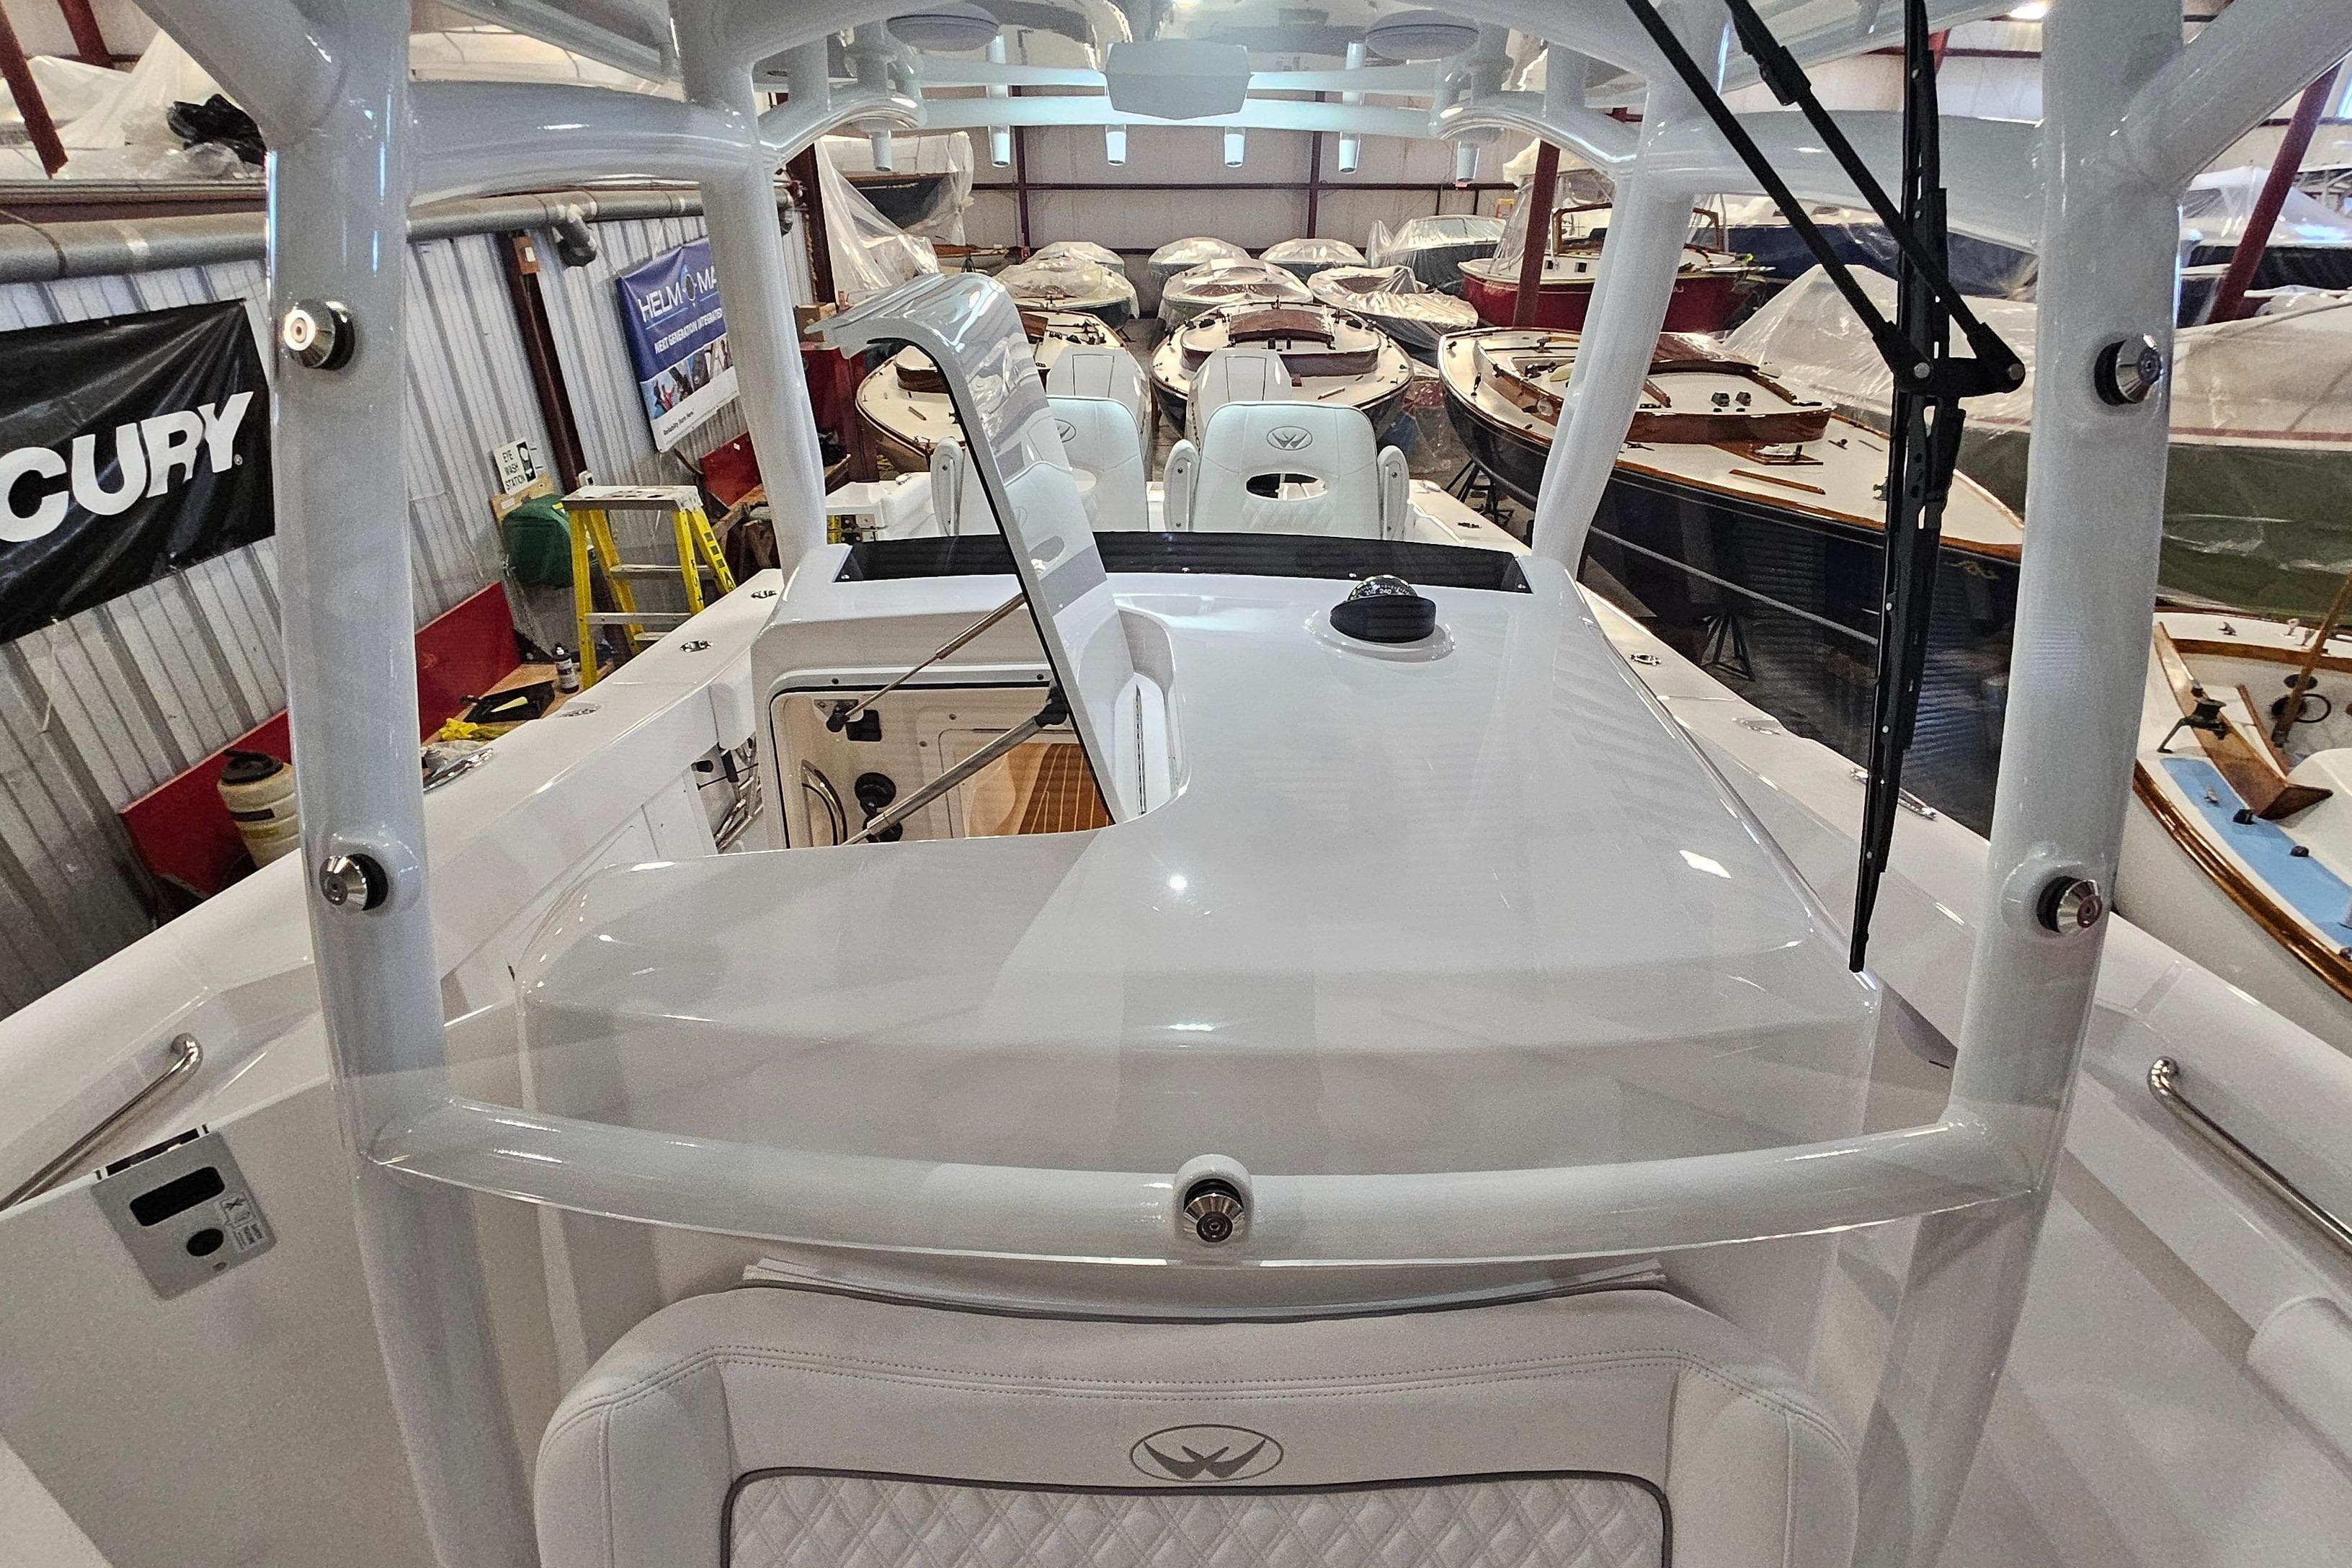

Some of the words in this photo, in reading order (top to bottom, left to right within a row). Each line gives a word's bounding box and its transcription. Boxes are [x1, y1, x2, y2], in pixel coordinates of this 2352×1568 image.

[638, 282, 684, 323] HELM
[654, 337, 669, 355] NEXT
[667, 320, 698, 347] GENERATION
[502, 450, 513, 463] EYE
[504, 462, 519, 476] WASH
[505, 475, 526, 491] STATION
